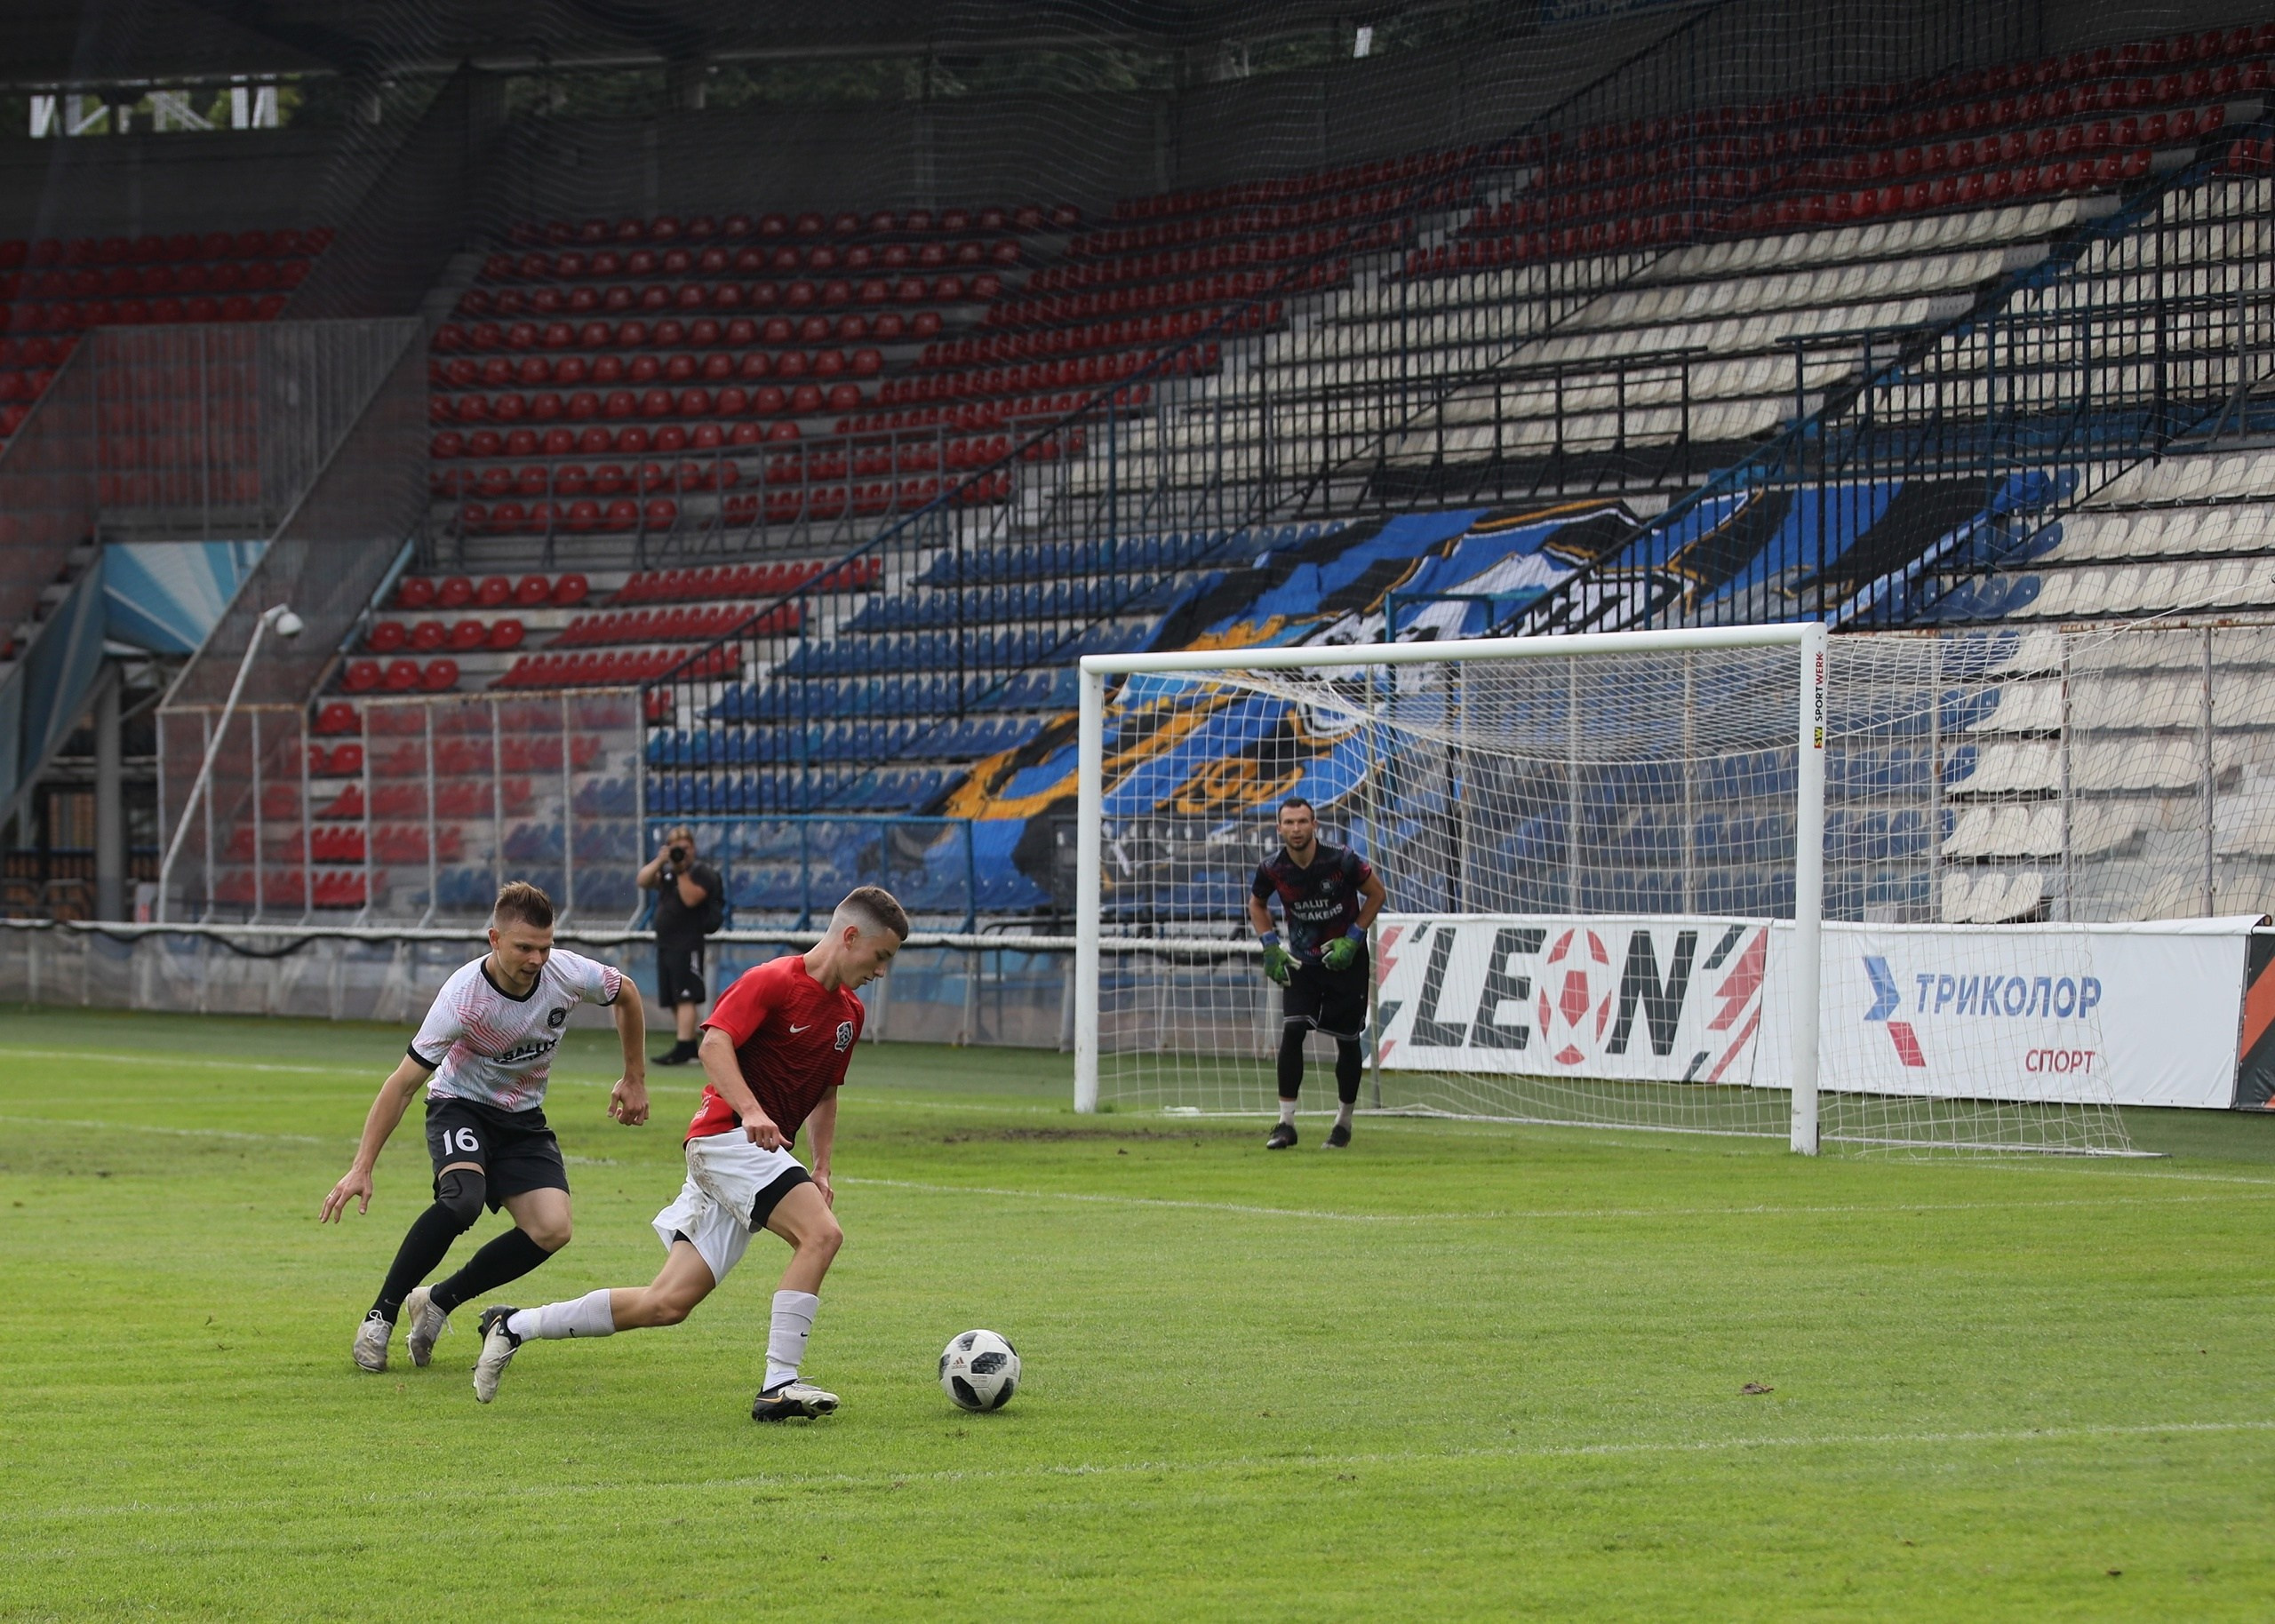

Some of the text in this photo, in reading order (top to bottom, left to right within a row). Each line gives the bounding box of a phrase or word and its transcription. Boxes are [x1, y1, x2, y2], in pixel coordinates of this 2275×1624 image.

[1815, 652, 1824, 721] SPORTWERK
[1294, 898, 1329, 910] SALUT
[1409, 927, 1699, 1065] LEON
[1915, 973, 2102, 1019] ТРИКОЛОР
[503, 1038, 557, 1060] SALUT
[2024, 1048, 2096, 1074] СПОРТ
[443, 1126, 480, 1157] 16
